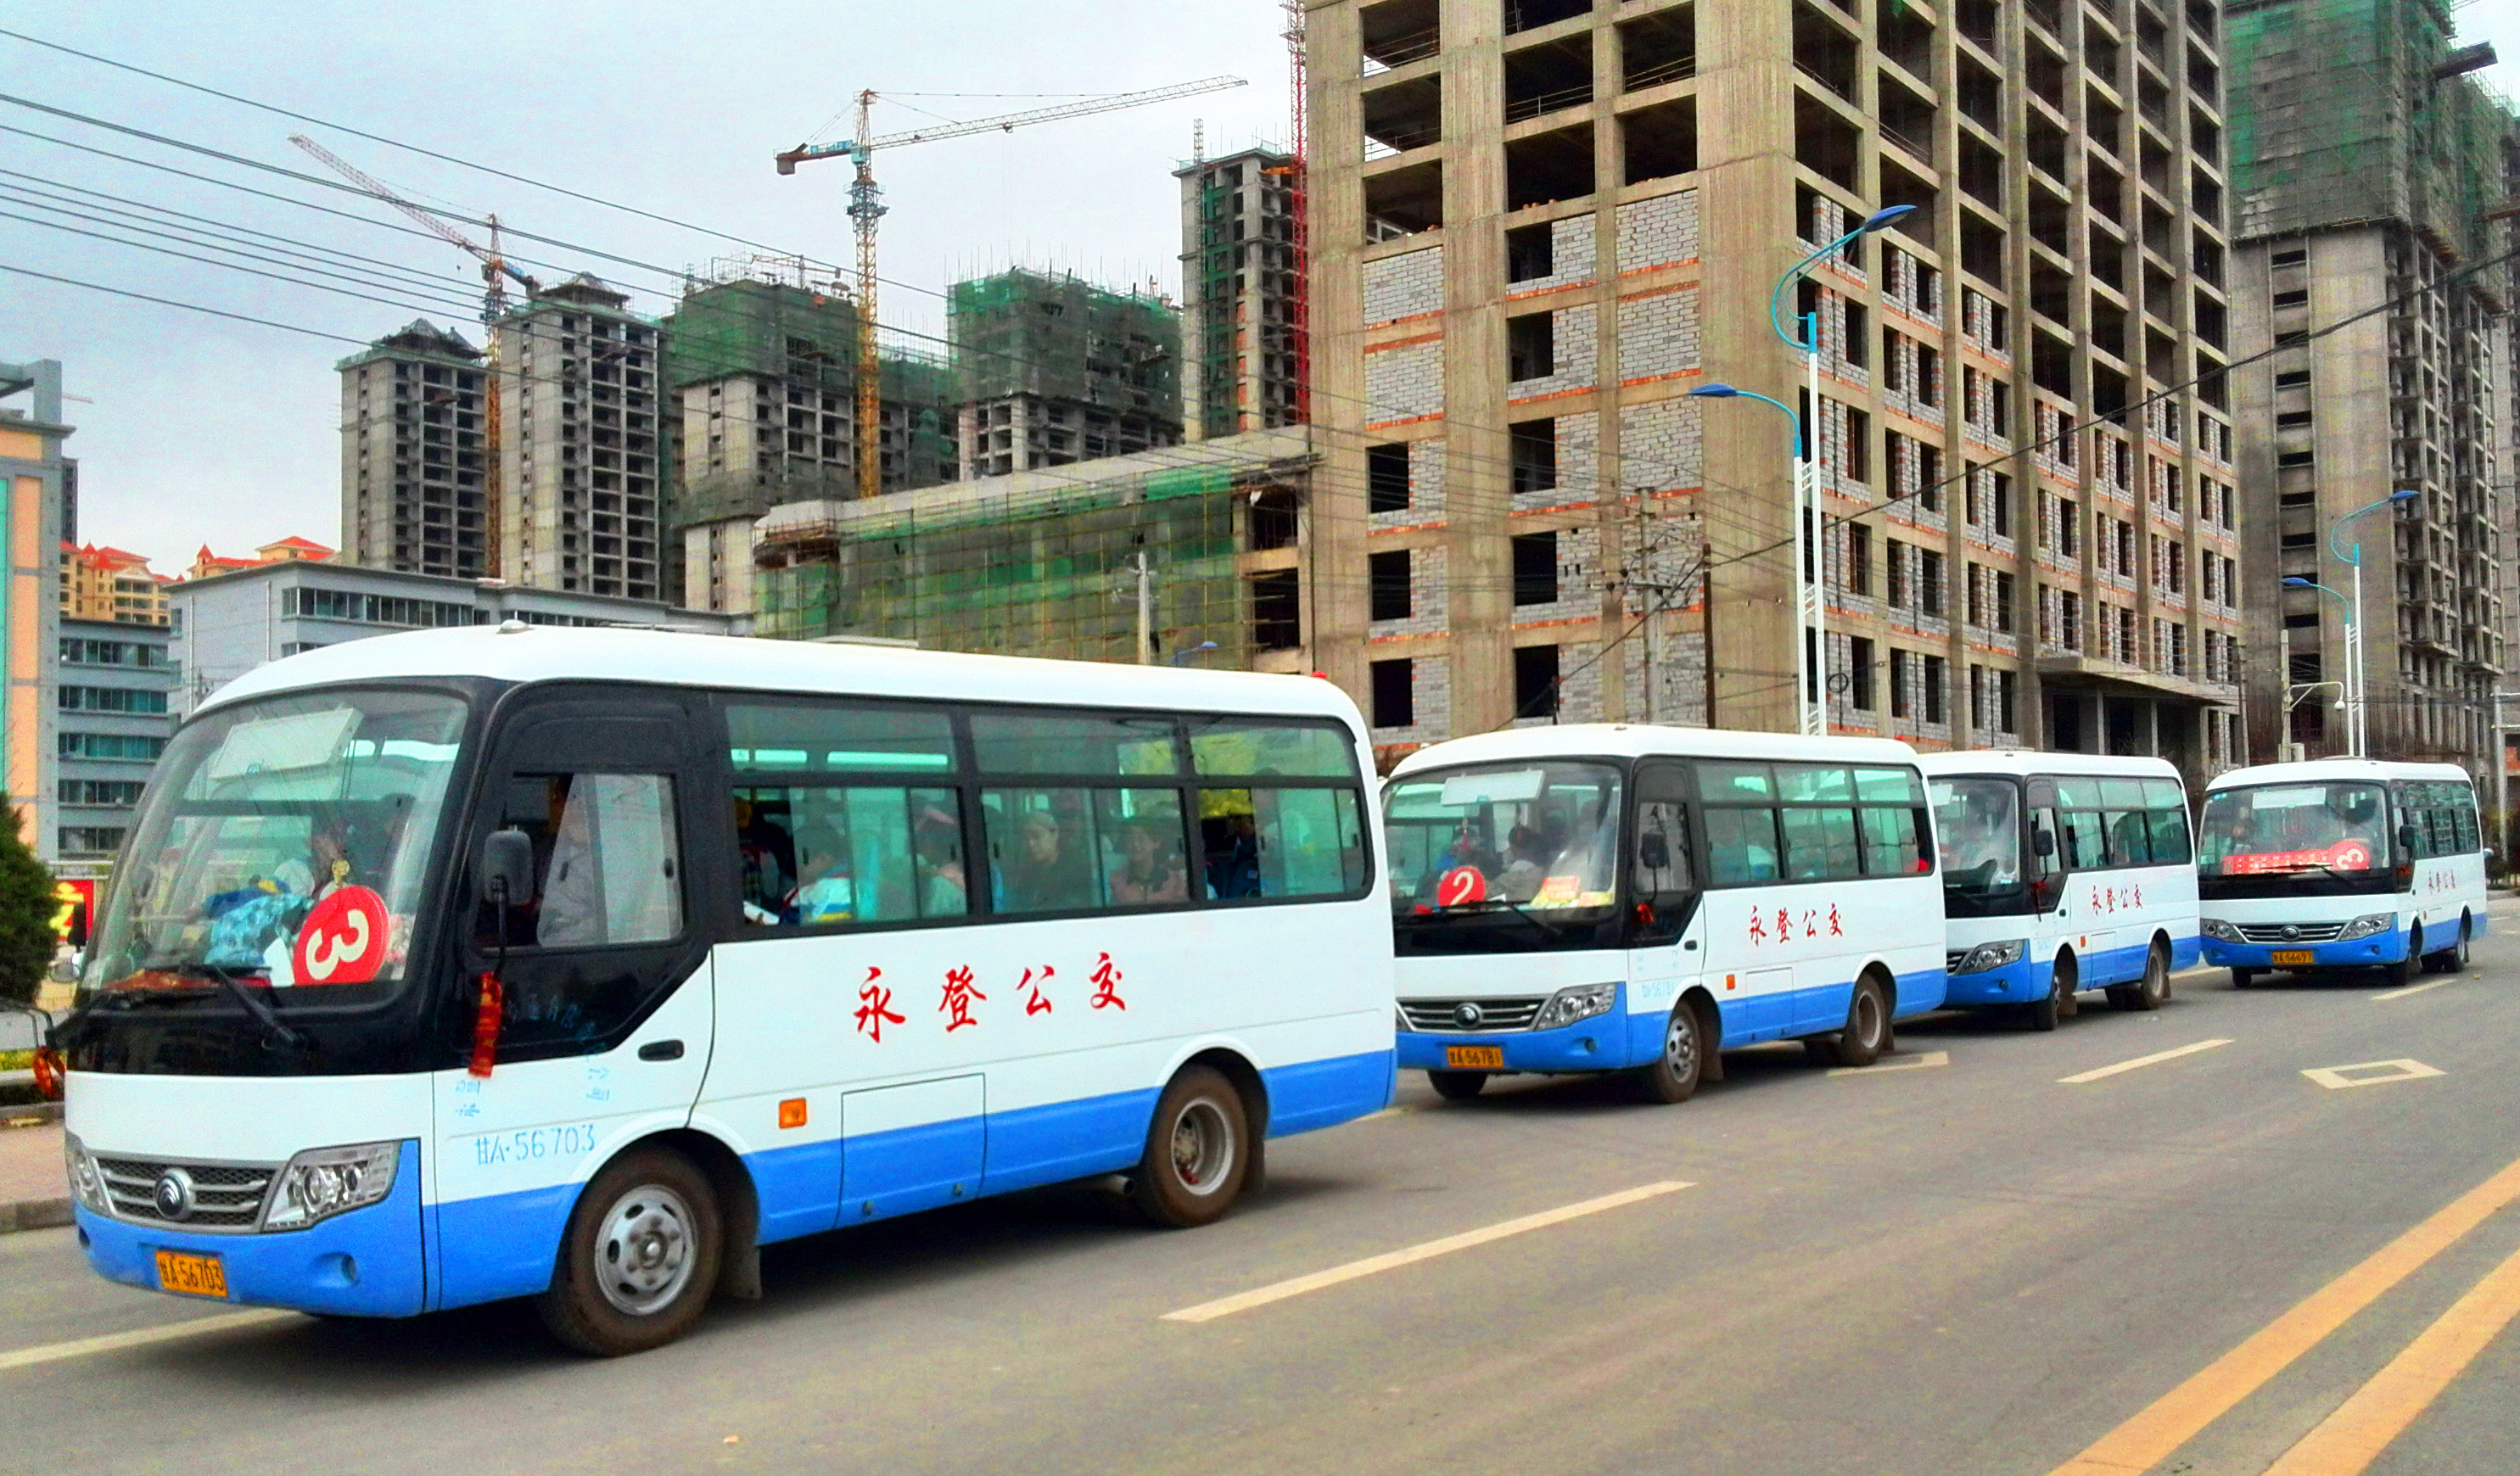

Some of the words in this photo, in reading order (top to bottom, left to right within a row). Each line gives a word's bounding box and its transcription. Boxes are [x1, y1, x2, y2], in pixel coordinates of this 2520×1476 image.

[2336, 847, 2365, 869] 3
[1449, 870, 1474, 905] 2
[2092, 883, 2143, 916] 永登公交
[1750, 902, 1843, 947] 永登公交
[305, 909, 369, 981] 3
[853, 952, 1127, 1043] 永登公交
